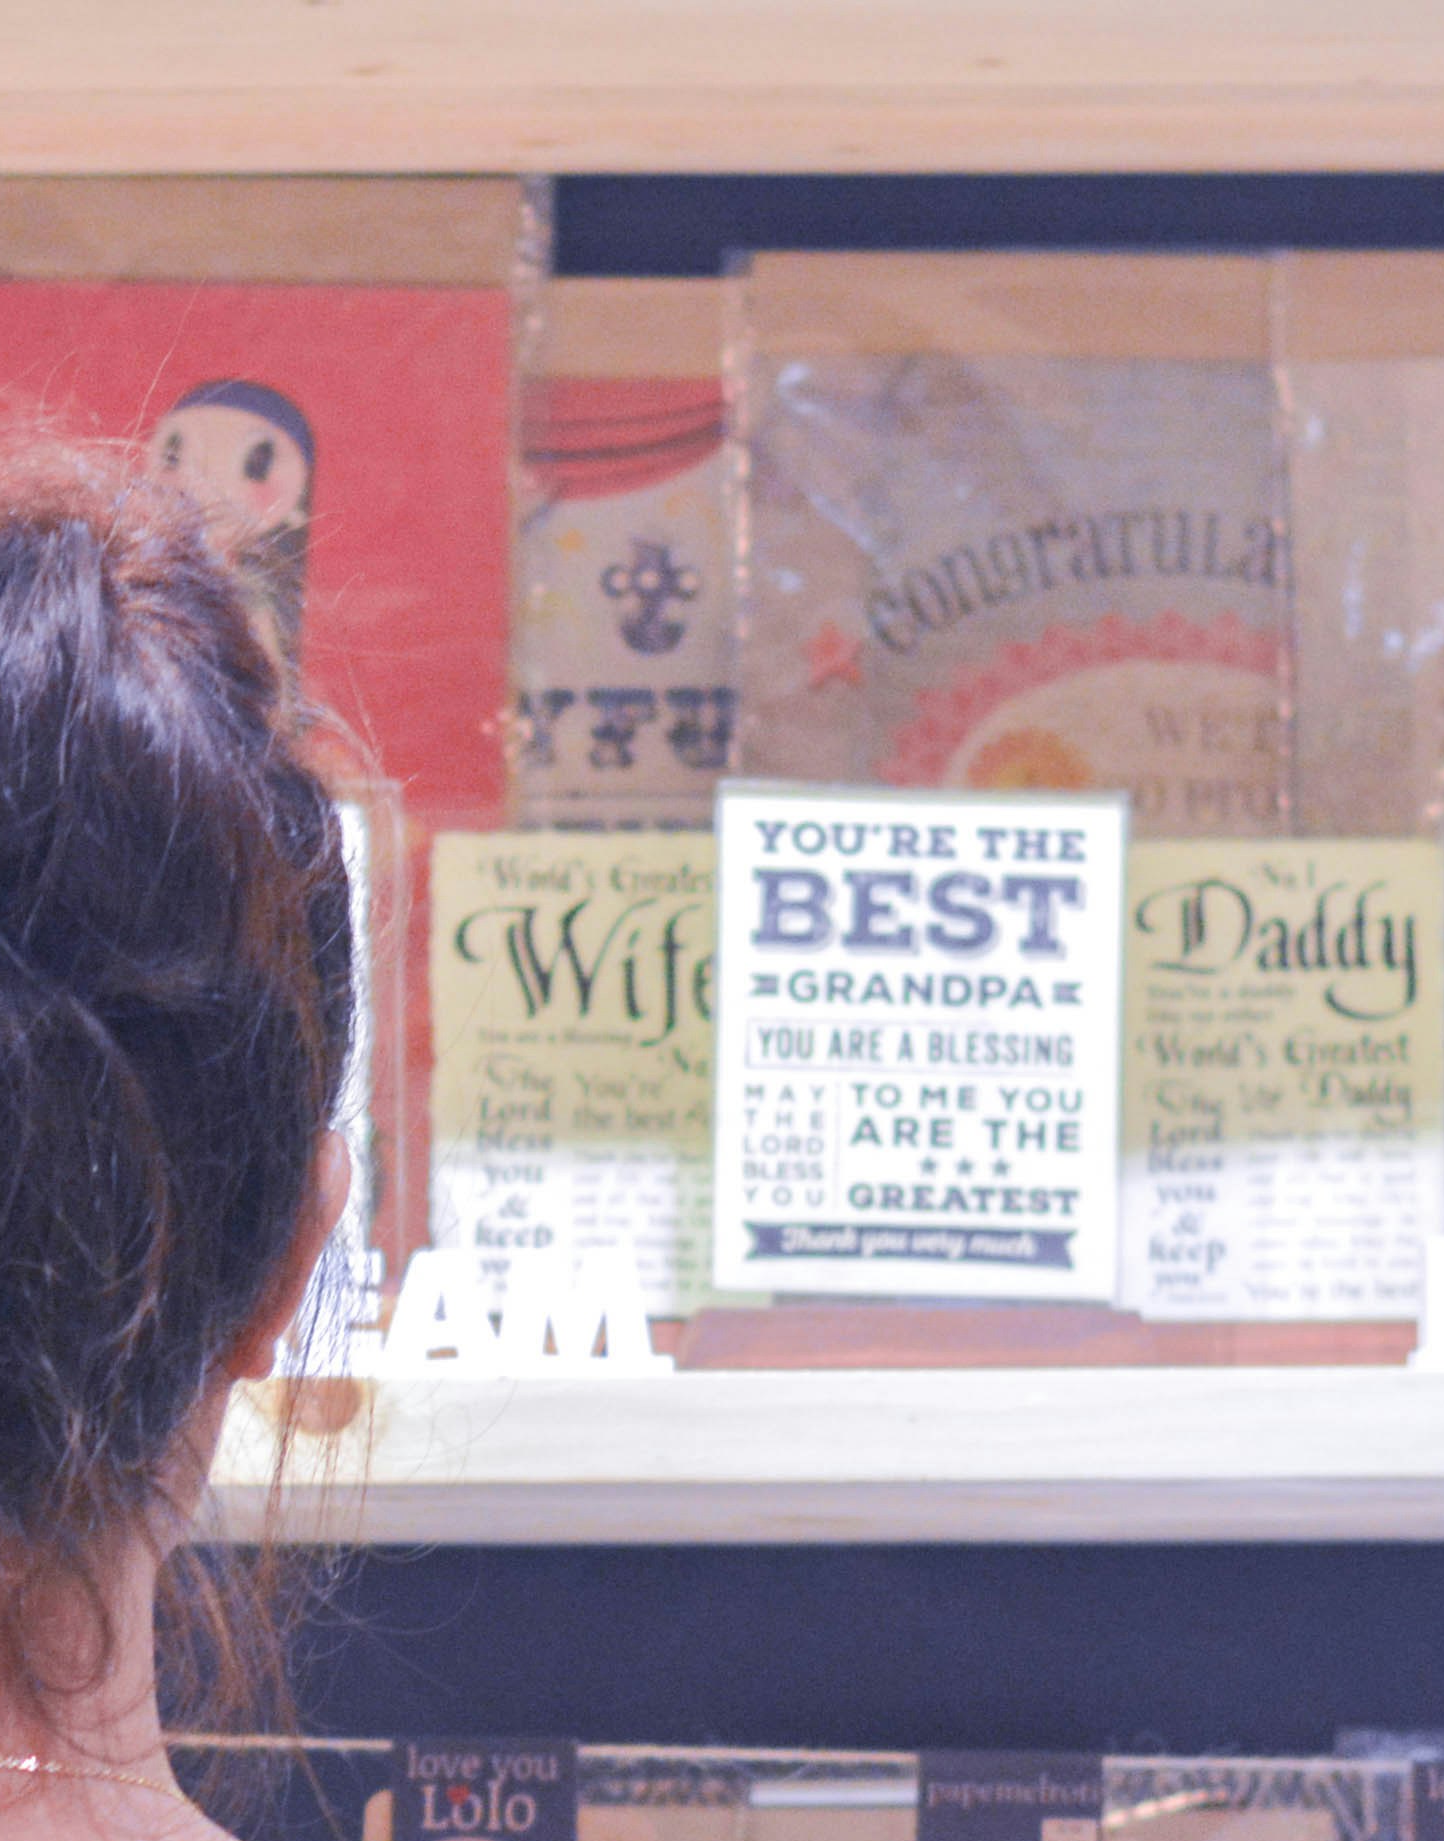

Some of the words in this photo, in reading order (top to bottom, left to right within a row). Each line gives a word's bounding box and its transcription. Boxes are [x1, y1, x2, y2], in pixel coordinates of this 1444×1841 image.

[754, 820, 957, 858] YOU'RE
[976, 827, 1086, 862] THE
[750, 867, 1085, 960] BEST
[1134, 876, 1418, 1021] Daddy
[786, 970, 1043, 1009] GRANDPA
[757, 1026, 813, 1059] YOU
[827, 1029, 883, 1062] ARE
[928, 1032, 1074, 1068] BLESSING
[850, 1082, 902, 1109] TO
[919, 1084, 978, 1111] ME
[998, 1086, 1084, 1114] YOU
[849, 1116, 954, 1150] ARE
[984, 1118, 1082, 1153] THE
[848, 1183, 1080, 1216] GREATEST
[407, 1744, 481, 1781] love
[491, 1752, 559, 1782] you
[421, 1779, 538, 1833] Lolo
